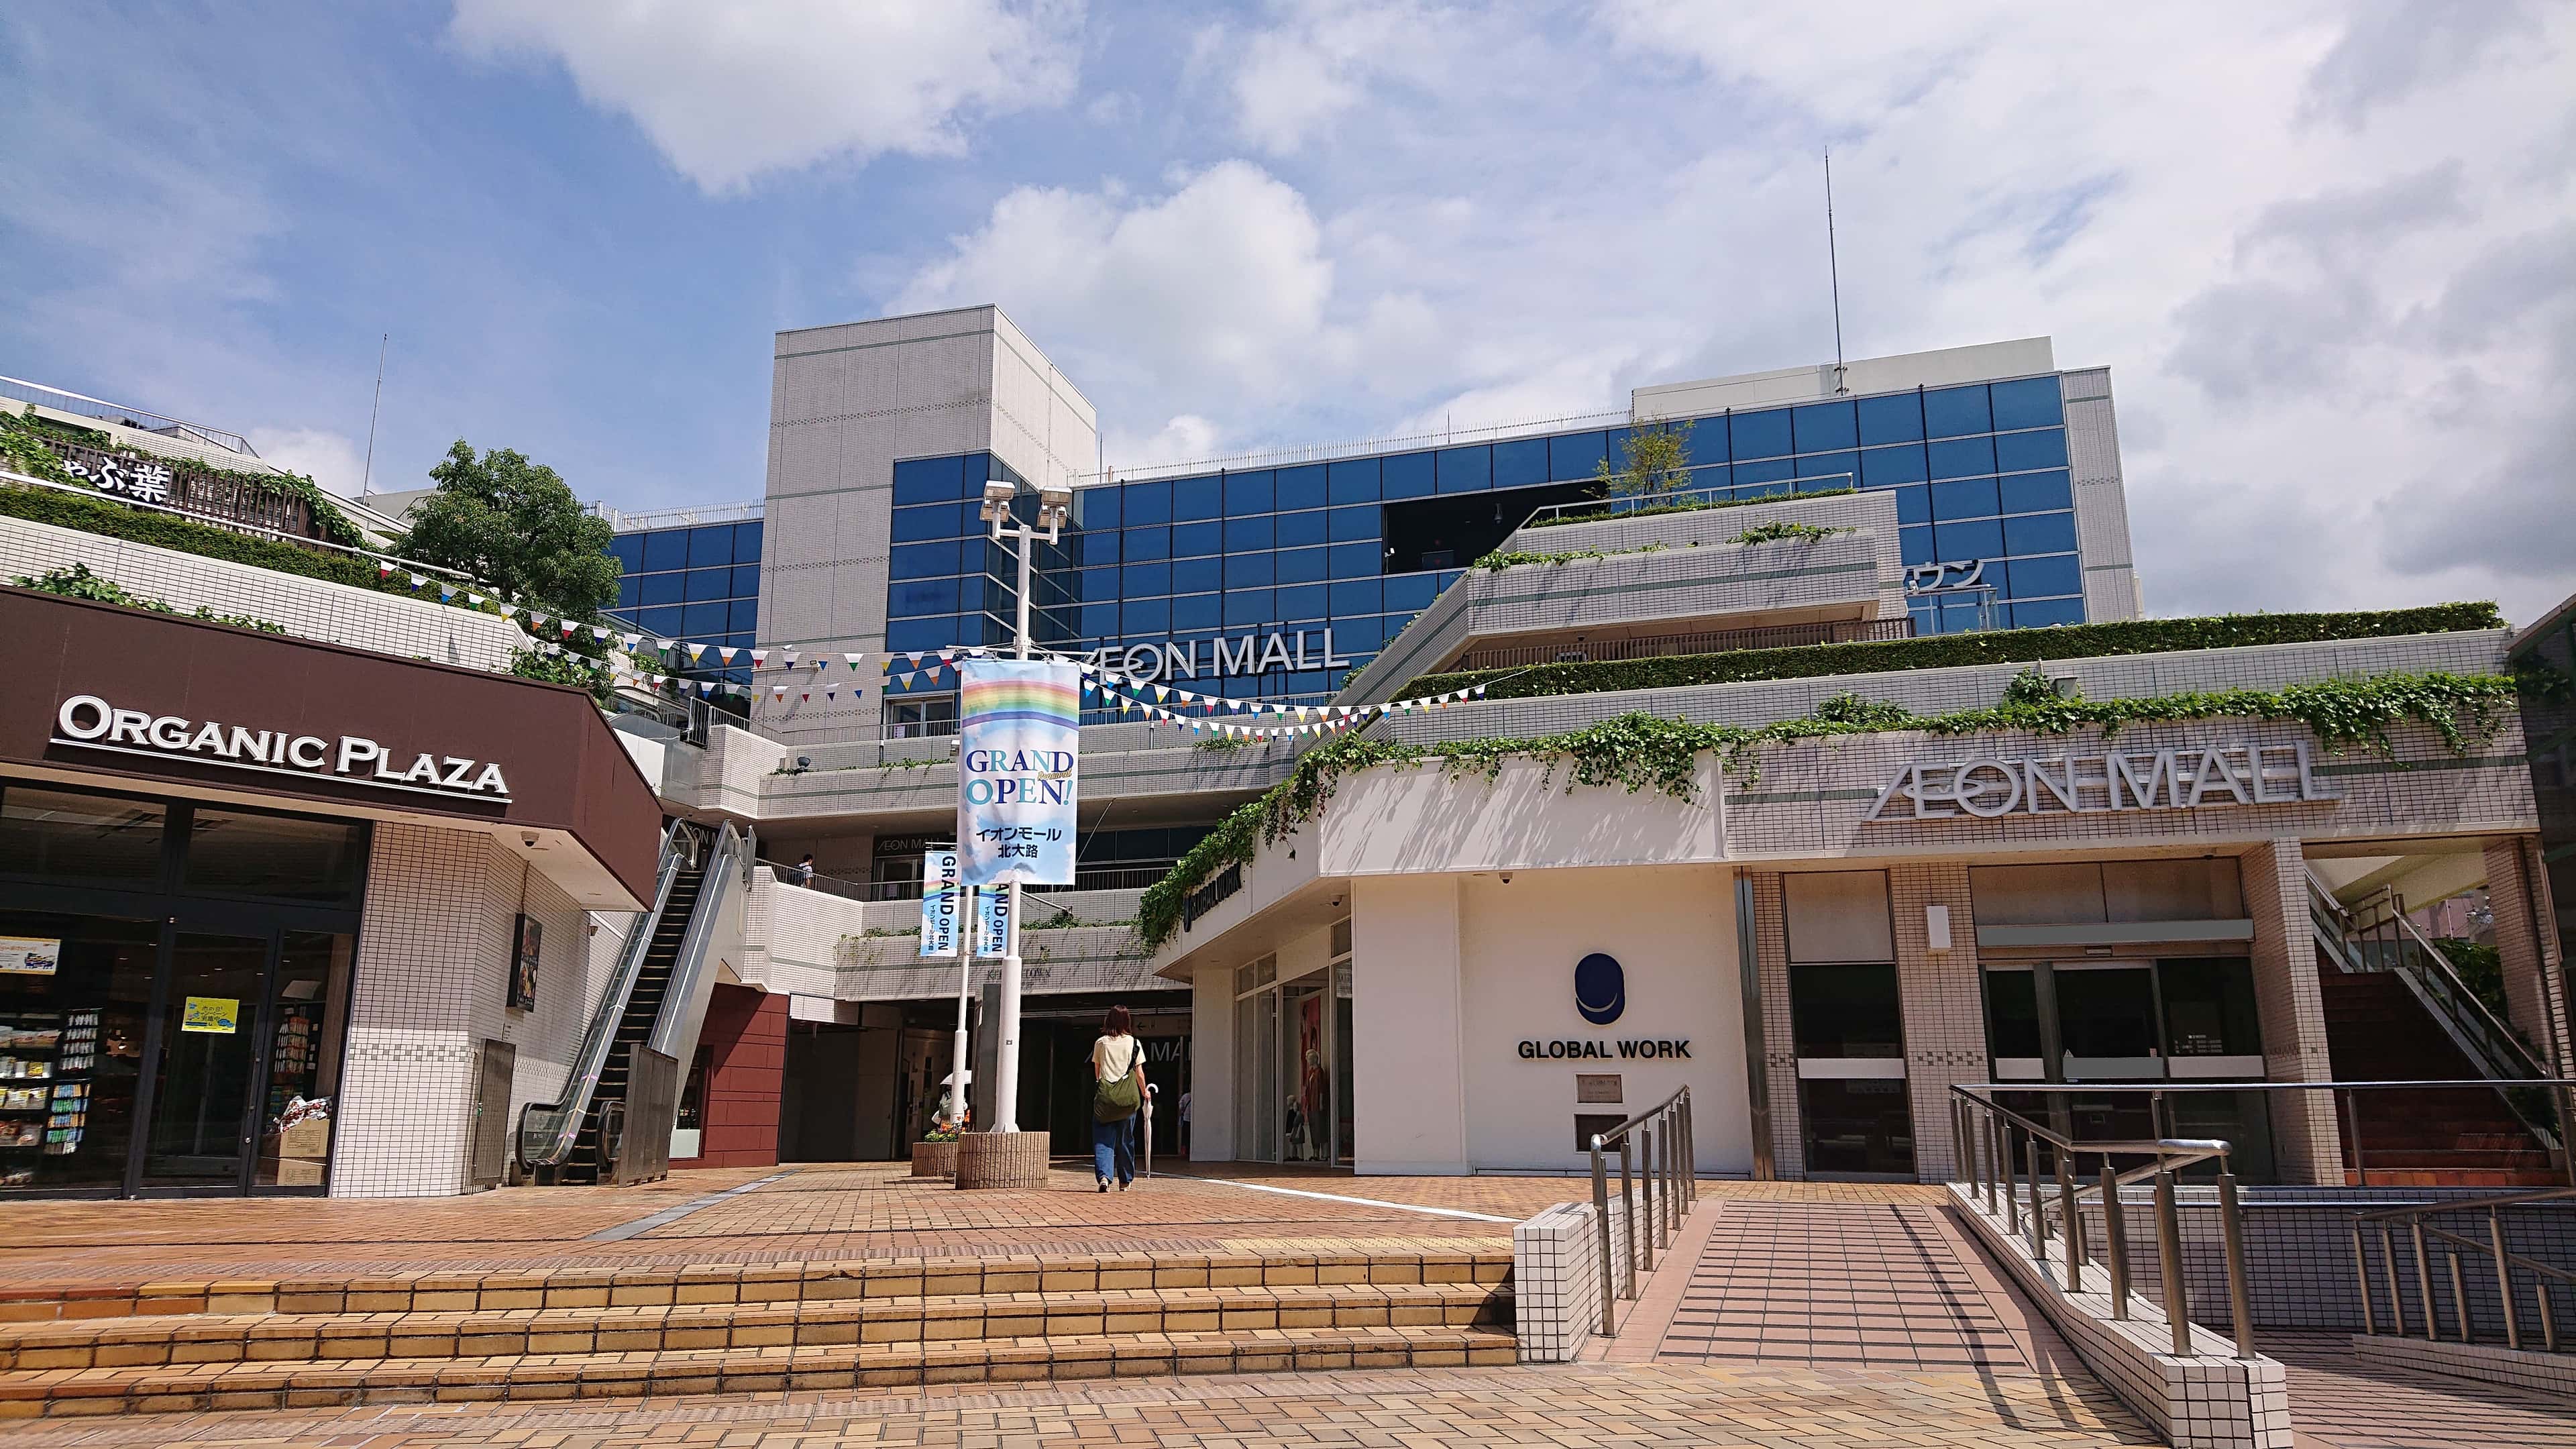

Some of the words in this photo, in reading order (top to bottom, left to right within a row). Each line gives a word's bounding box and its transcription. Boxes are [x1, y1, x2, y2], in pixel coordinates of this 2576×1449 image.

[1902, 561, 1985, 590] ウン
[1213, 627, 1350, 677] MALL
[58, 694, 329, 767] ORGANIC
[335, 735, 509, 794] PLAZA
[966, 749, 1074, 773] GRAND
[2105, 740, 2344, 811] MALL
[966, 777, 1073, 806] OPEN!
[976, 827, 1062, 842] イオンモール
[998, 843, 1038, 859] 北大路
[940, 856, 957, 915] GRAND
[994, 883, 1010, 917] AND
[938, 918, 950, 951] OPEN
[991, 920, 1004, 953] OPEN
[1517, 1040, 1613, 1059] GLOBAL
[1616, 1040, 1692, 1059] WORK
